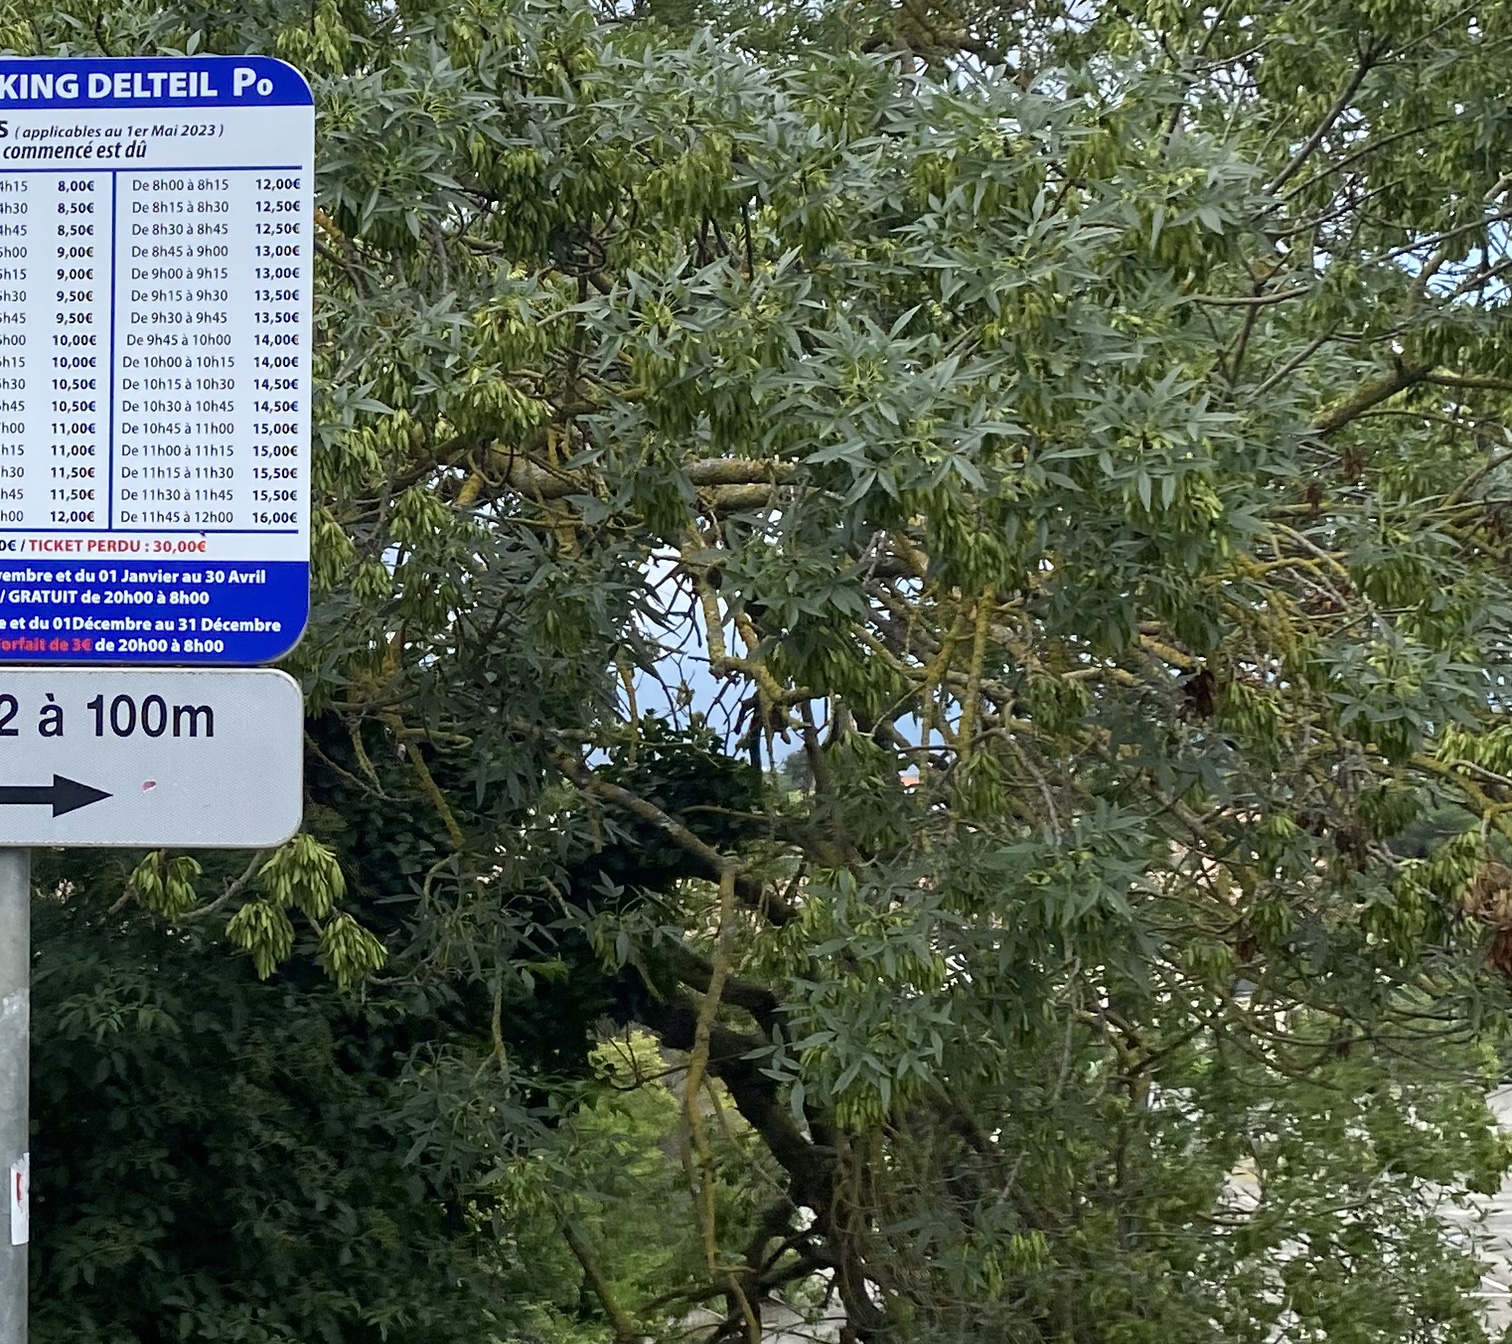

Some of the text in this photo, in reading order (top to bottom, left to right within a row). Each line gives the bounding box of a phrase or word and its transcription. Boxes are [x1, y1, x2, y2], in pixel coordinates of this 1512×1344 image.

[88, 72, 218, 99] DELTEIL
[22, 125, 102, 142] applicables
[104, 128, 123, 138] au
[127, 125, 149, 137] 1er
[150, 124, 178, 137] Mai
[180, 124, 216, 137] 2023
[2, 139, 93, 160] commencé
[96, 142, 122, 159] est
[124, 139, 147, 159] dû
[132, 178, 300, 192] De 8h00 à 8h15 12,00€
[56, 246, 94, 260] 9,00€
[126, 333, 299, 347] De 9h45 à 10h00 14,00€
[50, 466, 95, 480] 11,50€
[28, 539, 84, 552] TICKET
[87, 539, 140, 553] PERDU
[153, 540, 206, 554] 30,00€
[55, 569, 72, 583] et
[74, 568, 96, 583] du
[98, 569, 117, 583] 01
[120, 569, 180, 584] Janvier
[181, 572, 202, 584] au
[205, 570, 225, 584] 30
[227, 569, 266, 584] Avril
[8, 589, 78, 604] GRATUIT
[80, 589, 101, 604] de
[103, 590, 154, 605] 20h00
[156, 590, 166, 605] à
[168, 590, 210, 605] 8h00
[9, 617, 26, 630] et
[28, 616, 50, 630] du
[154, 620, 175, 632] au
[178, 617, 196, 632] 31
[201, 617, 282, 632] Décembre
[49, 639, 68, 651] de
[73, 638, 90, 652] 3€
[94, 637, 115, 652] de
[117, 638, 168, 653] 20h00
[170, 638, 180, 653] à
[183, 638, 224, 653] 8h00
[38, 692, 64, 738] à
[86, 694, 214, 738] 100m
